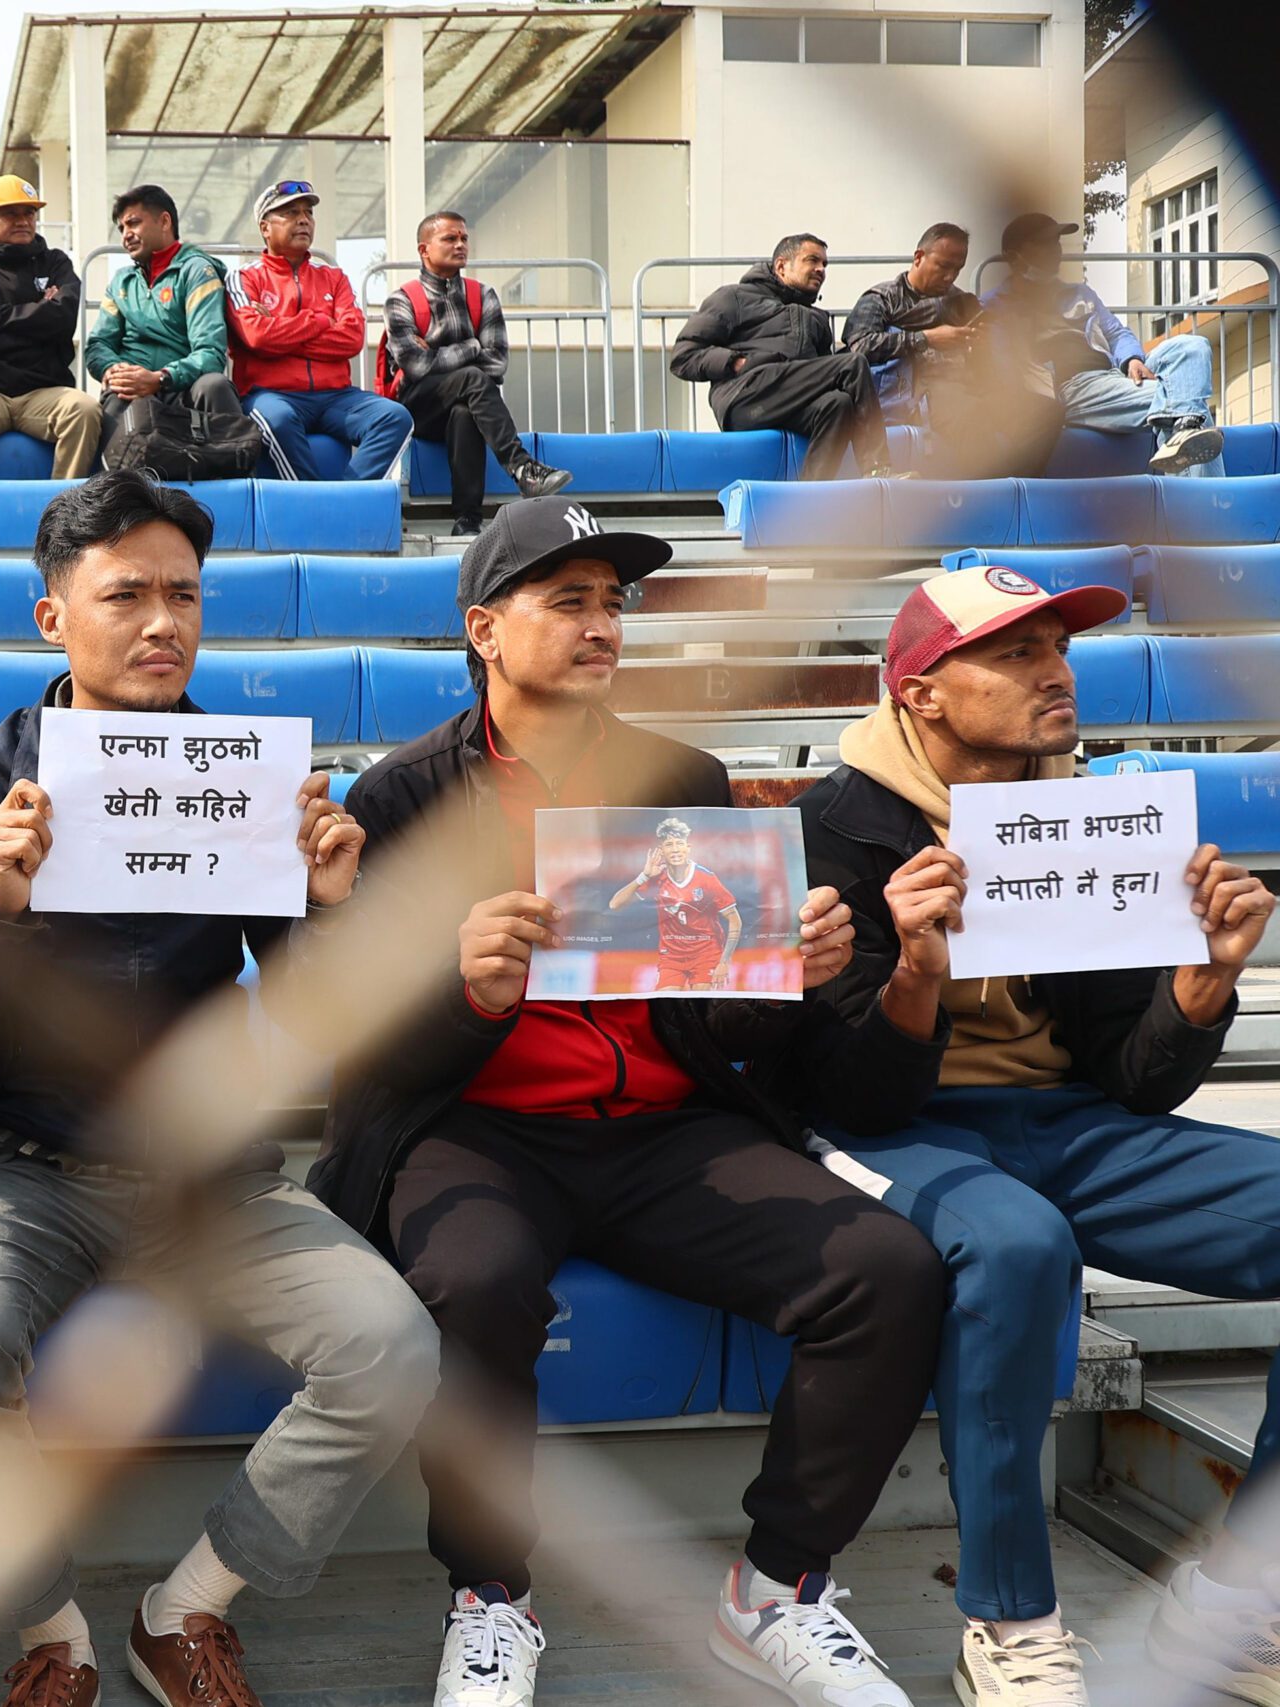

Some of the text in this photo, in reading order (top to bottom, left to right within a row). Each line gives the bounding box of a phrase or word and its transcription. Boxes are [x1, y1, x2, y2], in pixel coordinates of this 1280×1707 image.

[704, 668, 731, 700] E
[99, 730, 262, 773] एन्फा झुठको
[103, 787, 252, 823] खेती कहिले
[995, 804, 1163, 846] सबित्रा भण्डारी
[125, 852, 219, 876] सम्म ?
[985, 867, 1159, 912] नेपाली नै हुन।
